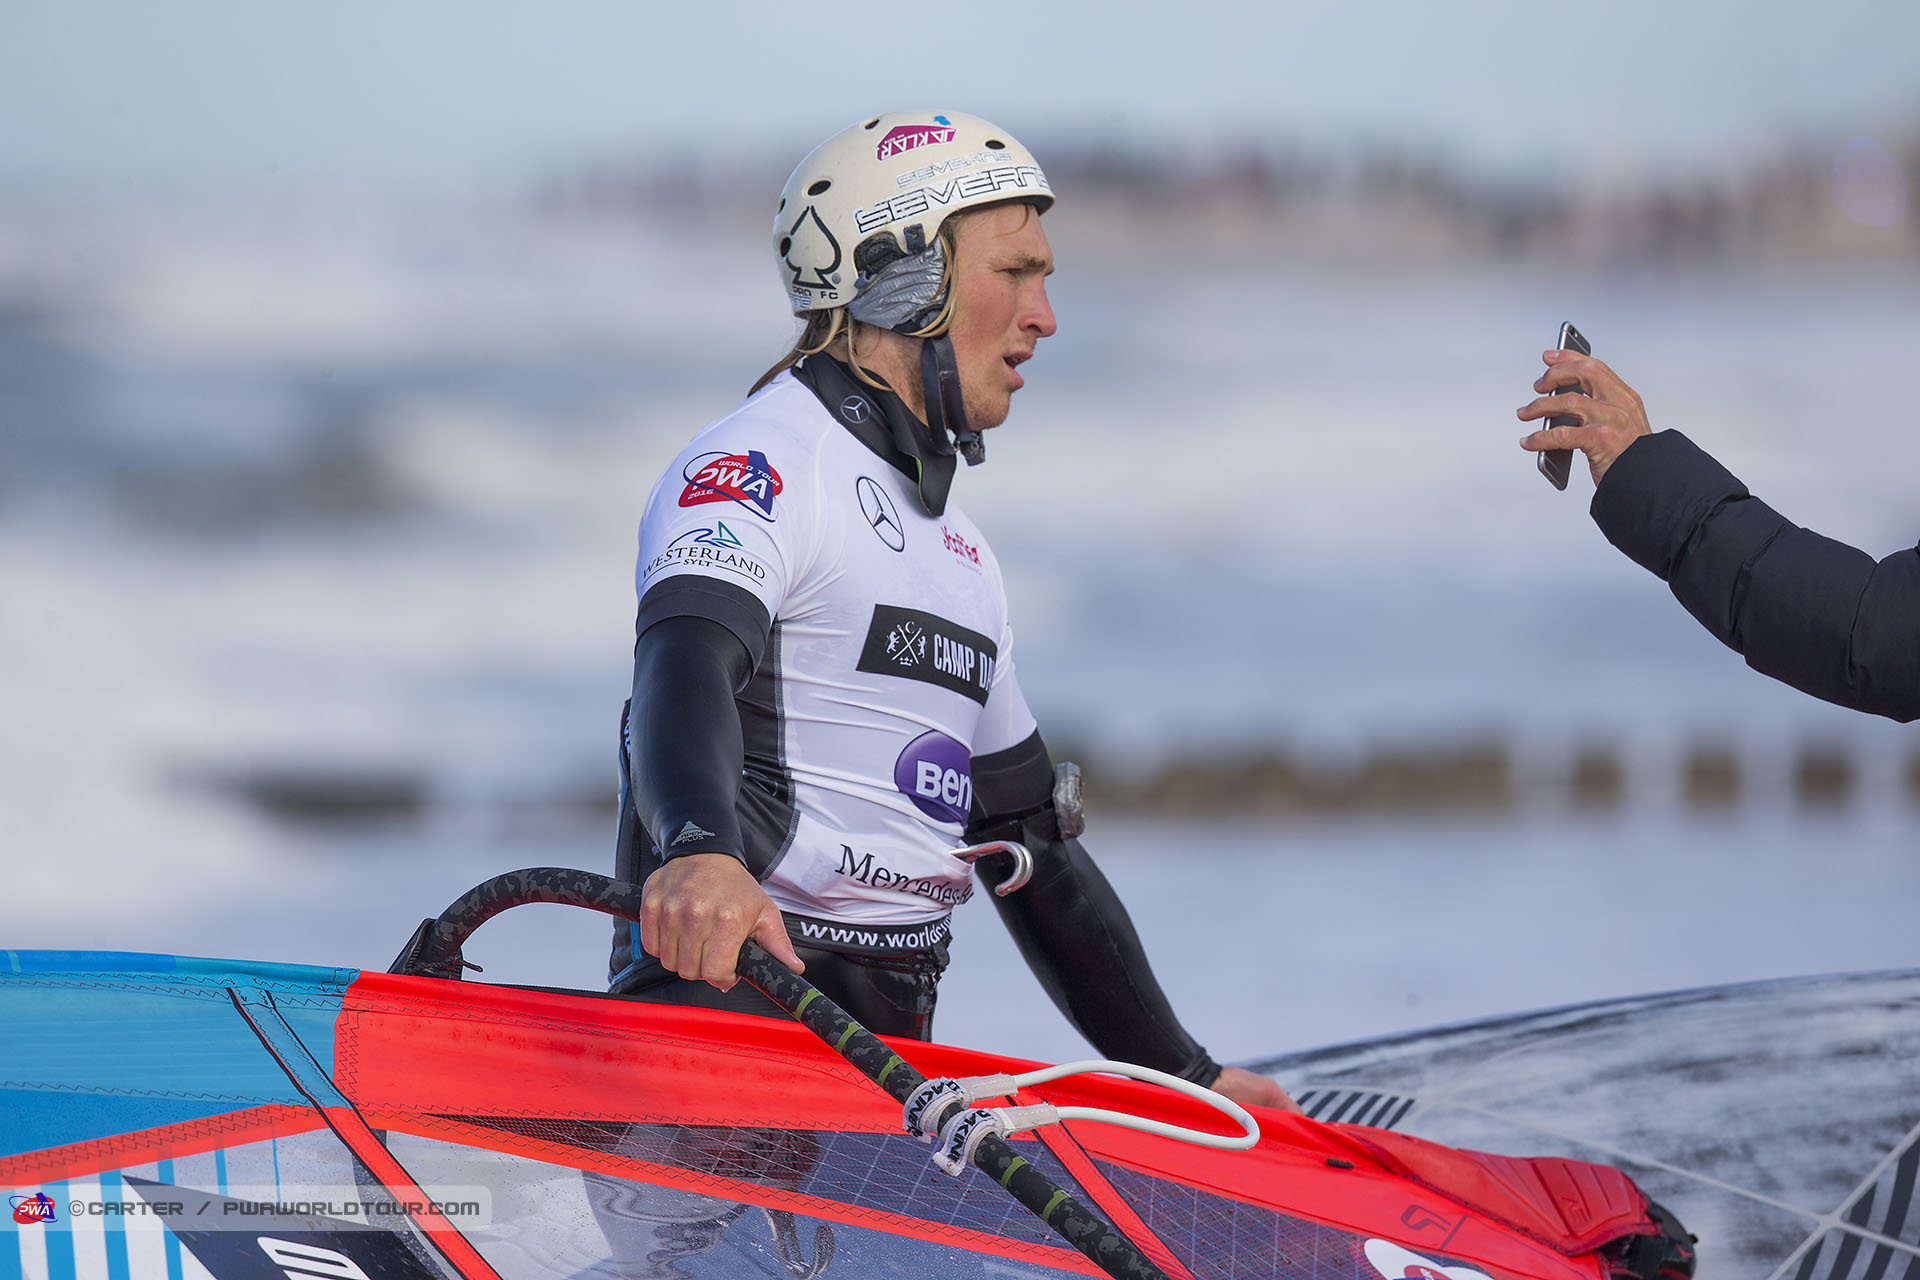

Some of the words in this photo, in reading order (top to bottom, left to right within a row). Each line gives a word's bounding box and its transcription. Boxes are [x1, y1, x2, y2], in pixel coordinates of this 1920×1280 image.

[692, 467, 768, 499] PWA
[718, 460, 753, 472] WORLD
[757, 470, 780, 487] TOUR
[686, 488, 714, 500] 2016
[643, 547, 766, 580] WESTERLAND
[683, 558, 712, 567] SYLT
[933, 633, 975, 682] CAMP
